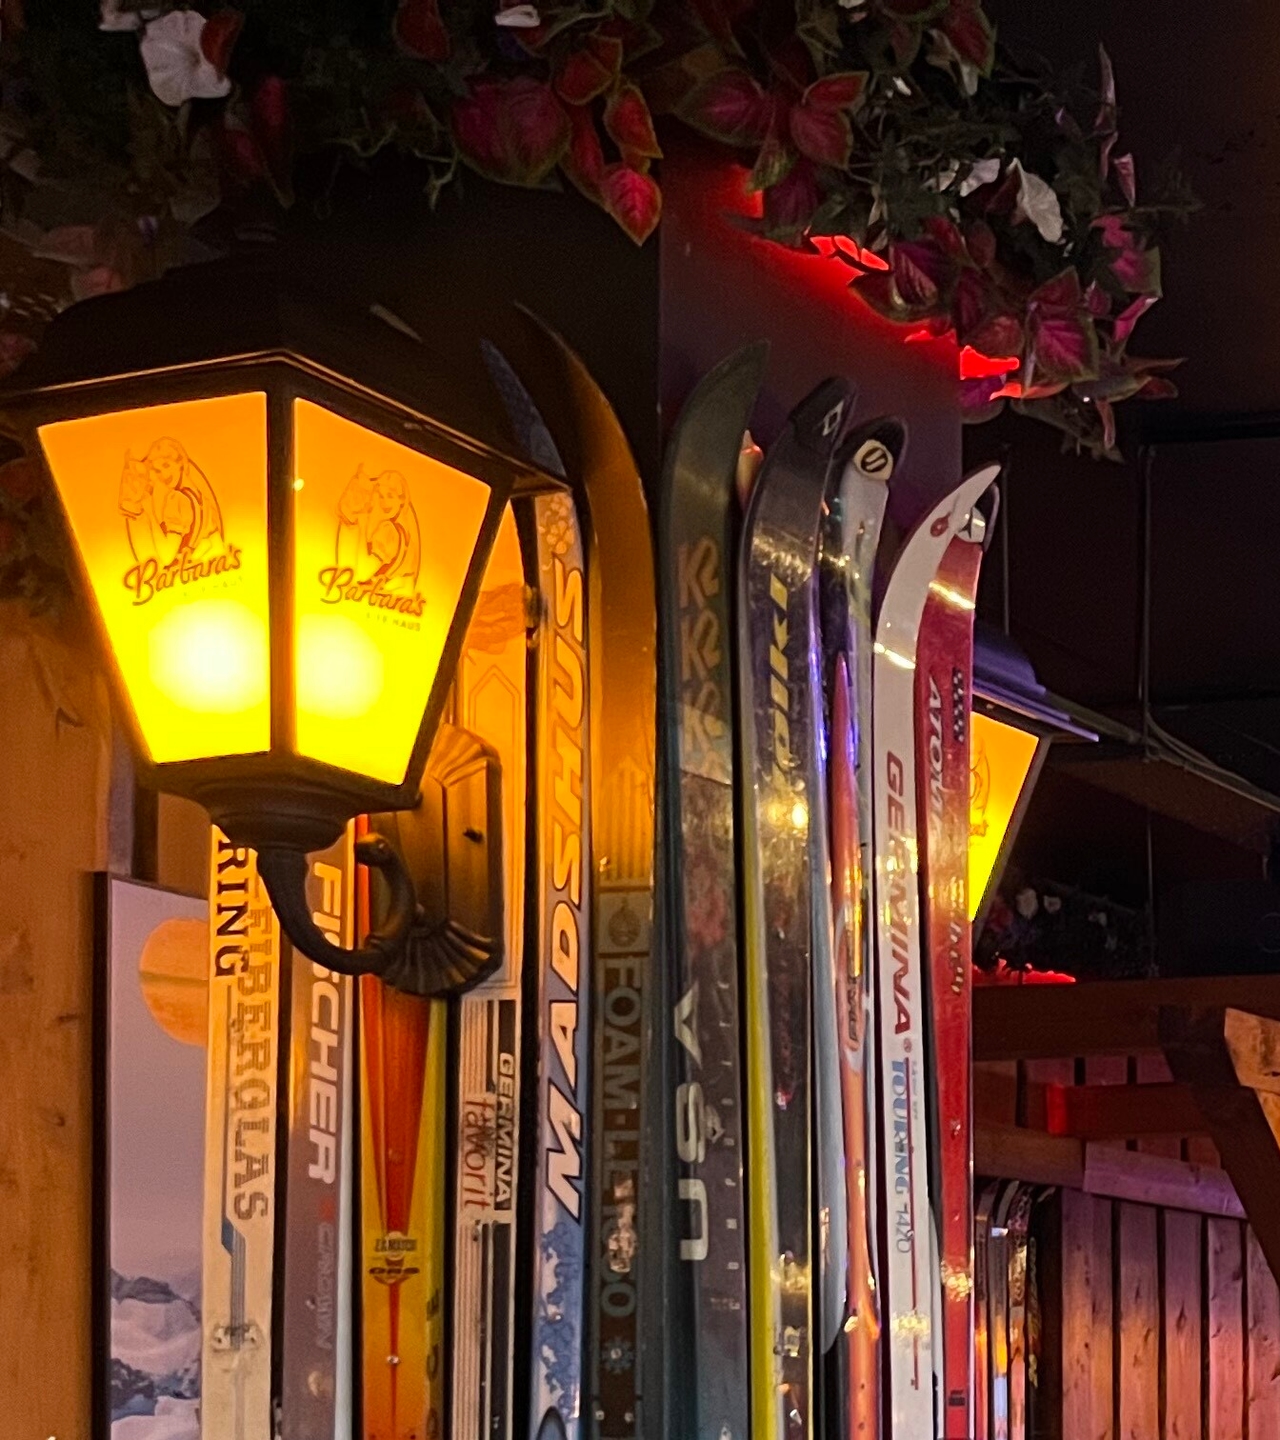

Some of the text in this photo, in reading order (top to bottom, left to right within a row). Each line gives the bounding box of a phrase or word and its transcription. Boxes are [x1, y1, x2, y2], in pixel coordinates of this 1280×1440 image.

[123, 545, 243, 606] Barbara's
[318, 566, 427, 617] Barbara's
[545, 556, 584, 1223] MADSHUS
[308, 862, 343, 1185] FISCHER
[496, 1052, 514, 1203] GERMINA
[890, 1060, 911, 1196] TOURING
